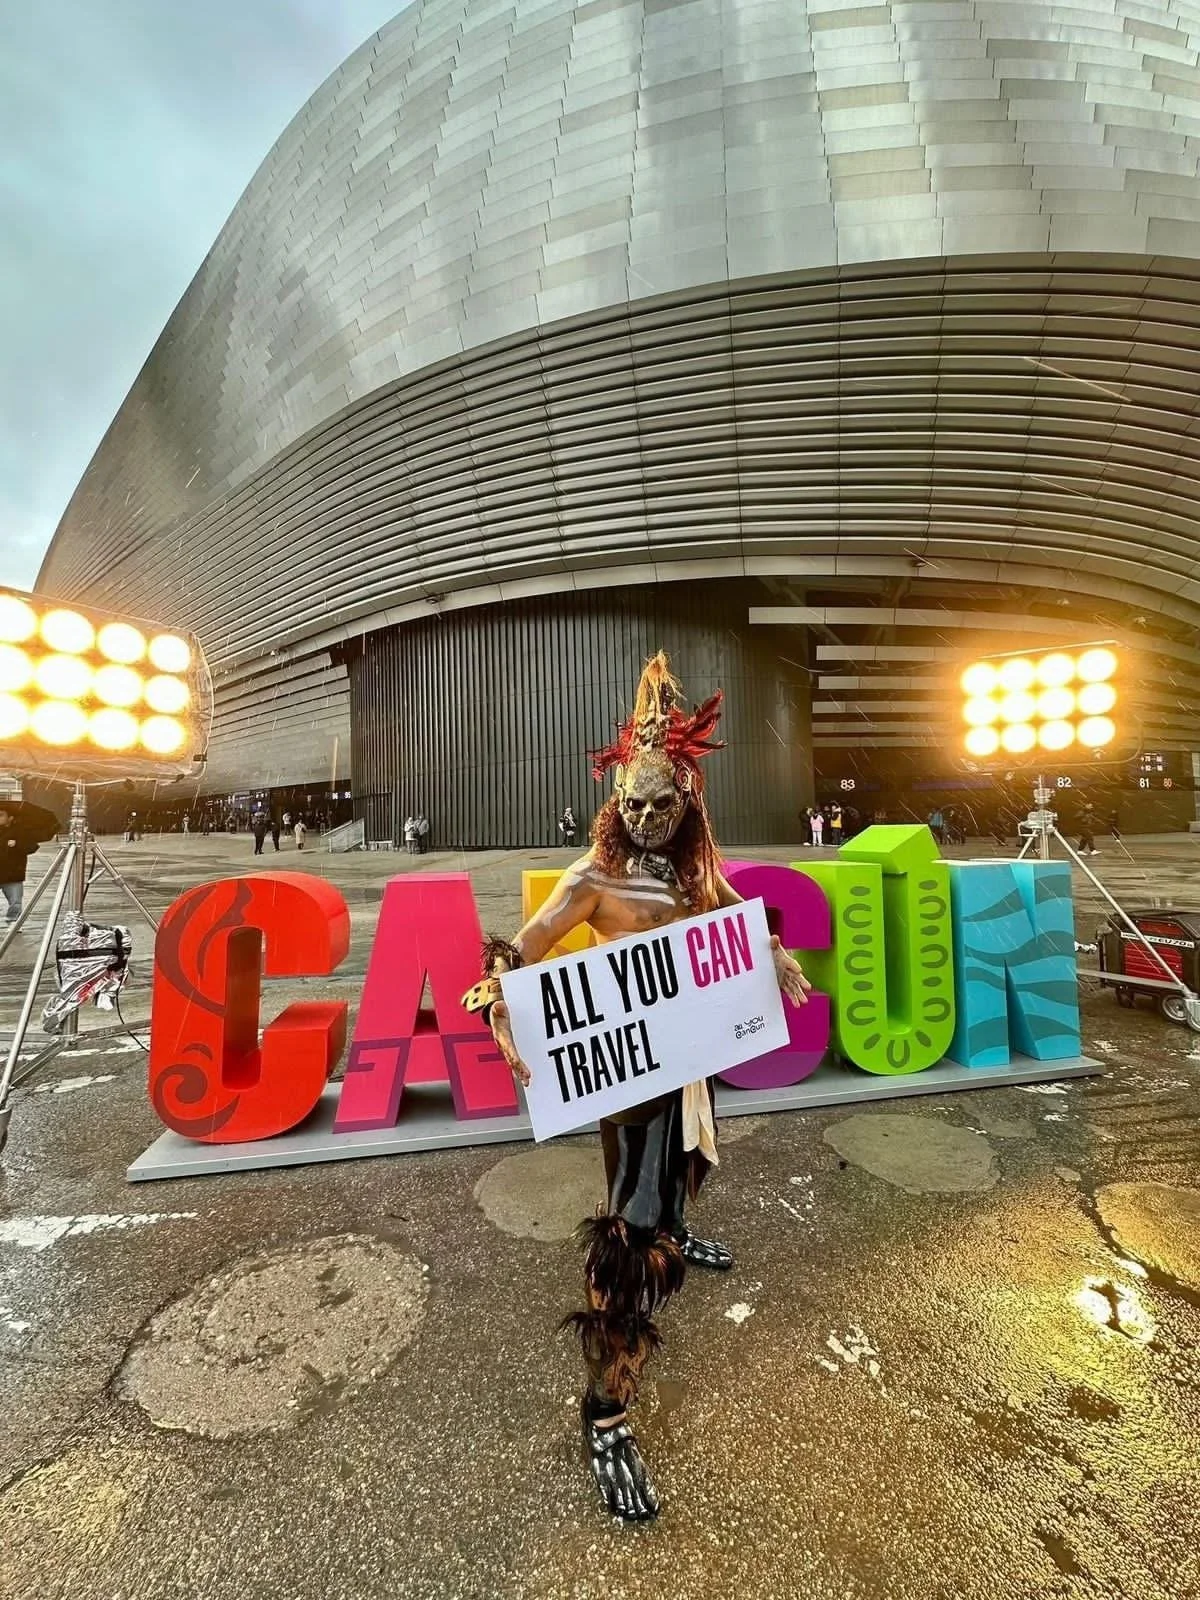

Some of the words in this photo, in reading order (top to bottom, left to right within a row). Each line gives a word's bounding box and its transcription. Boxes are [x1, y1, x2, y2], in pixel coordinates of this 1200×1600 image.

[840, 779, 855, 790] 83
[1057, 776, 1071, 788] 82
[1139, 777, 1149, 788] 81
[149, 824, 1081, 1143] CACÚN
[540, 961, 605, 1039] ALL
[607, 936, 679, 1013] YOU
[685, 912, 754, 988] CAN
[547, 1019, 661, 1104] TRAVEL
